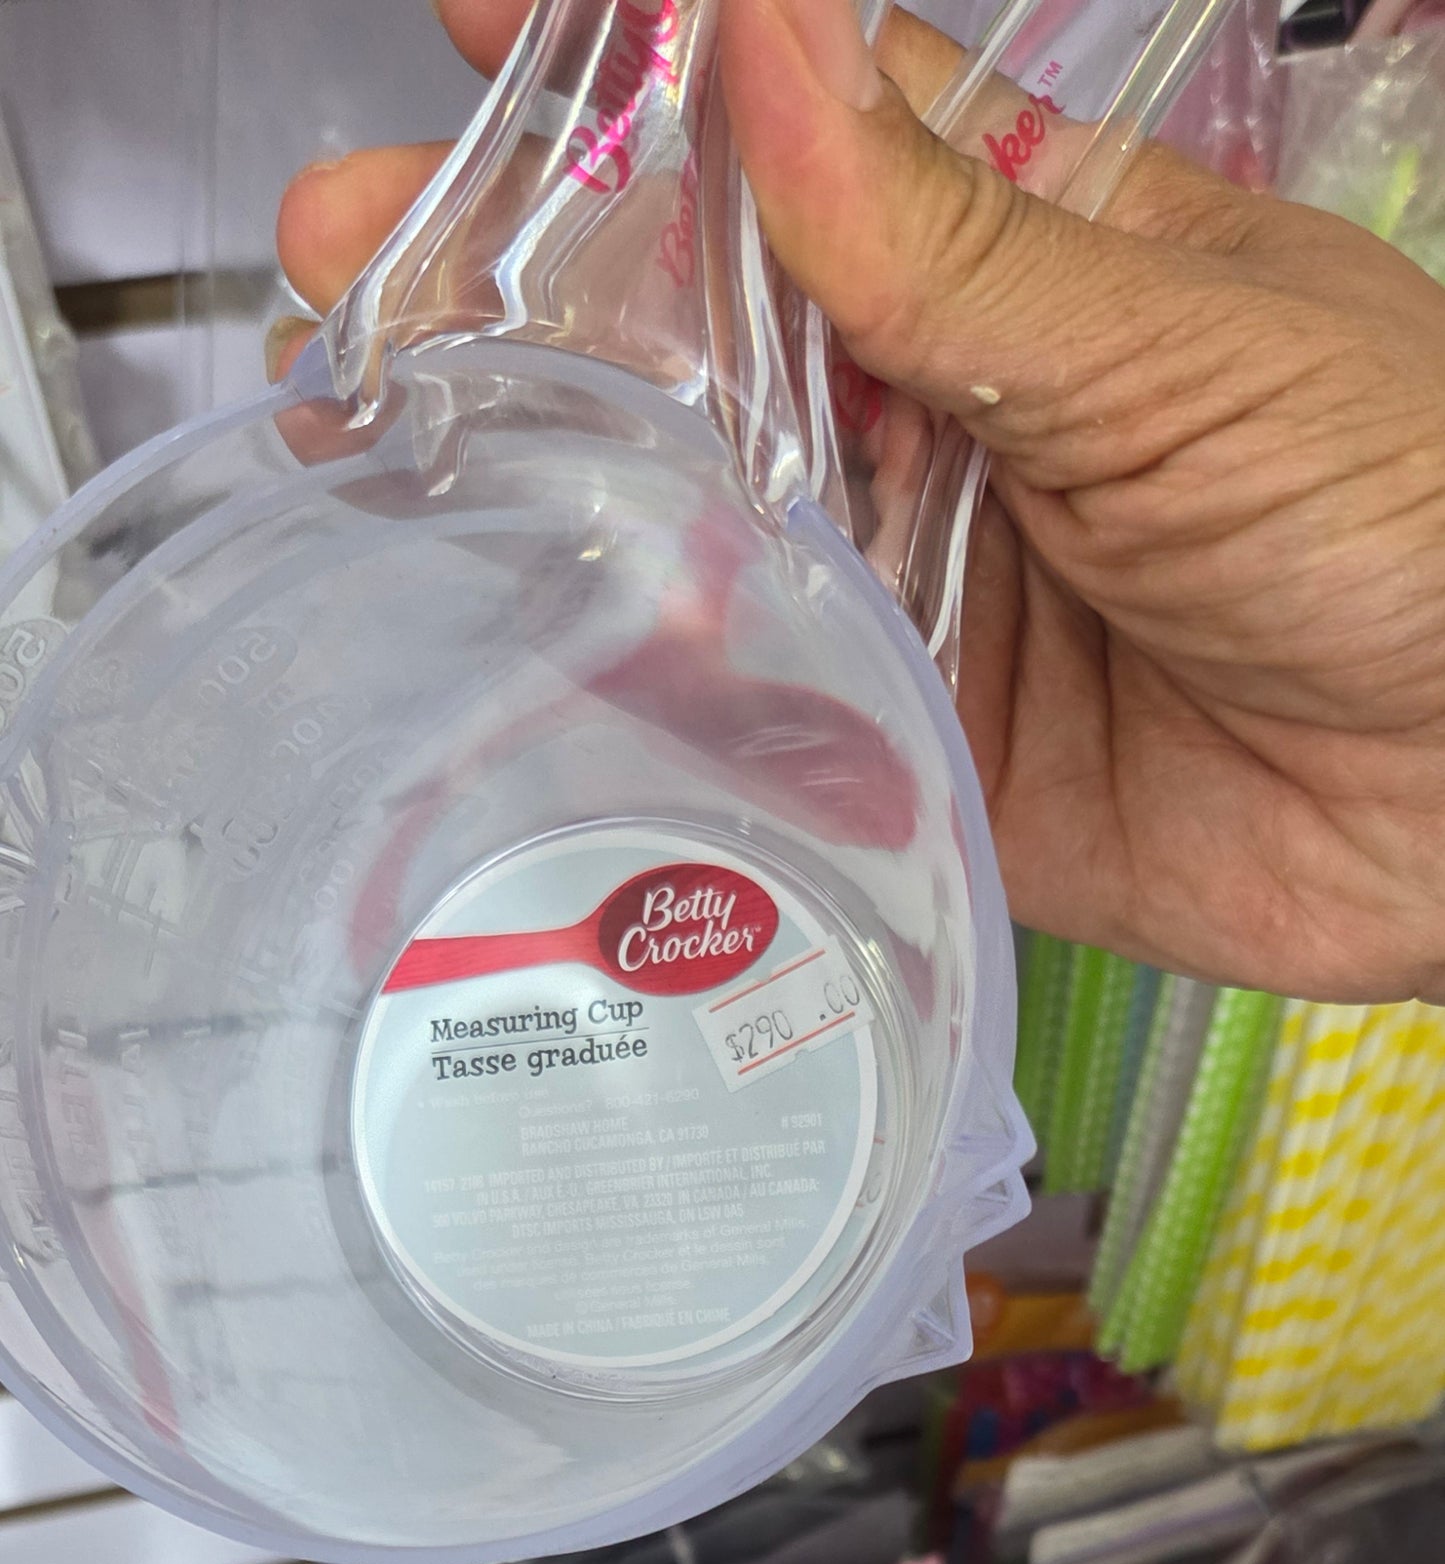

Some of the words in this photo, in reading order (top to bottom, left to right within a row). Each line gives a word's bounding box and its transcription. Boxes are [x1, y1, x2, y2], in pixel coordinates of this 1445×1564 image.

[643, 887, 737, 931] Betty
[618, 920, 753, 972] Crocker
[430, 1005, 579, 1043] Measuring
[587, 1000, 643, 1027] Cup
[432, 1052, 517, 1081] Tasse
[527, 1034, 648, 1077] graduée
[520, 1120, 591, 1141] BRADSHAW
[593, 1116, 629, 1134] HOME
[521, 1140, 572, 1157] RANCHO
[658, 1128, 675, 1144] CA
[488, 1169, 545, 1189] IMPORTED
[548, 1166, 571, 1182] AND
[574, 1158, 647, 1178] DISTRIBUTED
[649, 1156, 664, 1172] BY
[672, 1146, 724, 1169] IMPORTÉ
[725, 1148, 739, 1164] ET
[741, 1138, 801, 1162] DISTRIBUÉ
[802, 1139, 826, 1155] PAR
[585, 1174, 656, 1196] GREENBRIER
[451, 1209, 488, 1227] VOLVO
[677, 1190, 691, 1205] IN
[693, 1186, 741, 1204] CANADA
[749, 1182, 766, 1198] AU
[511, 1223, 541, 1239] DTSC
[543, 1217, 593, 1237] IMPORTS
[679, 1208, 696, 1223] ON
[719, 1221, 772, 1238] General
[527, 1321, 561, 1339] MADE
[562, 1319, 575, 1335] IN
[576, 1317, 614, 1335] CHINA
[677, 1309, 694, 1325] EN
